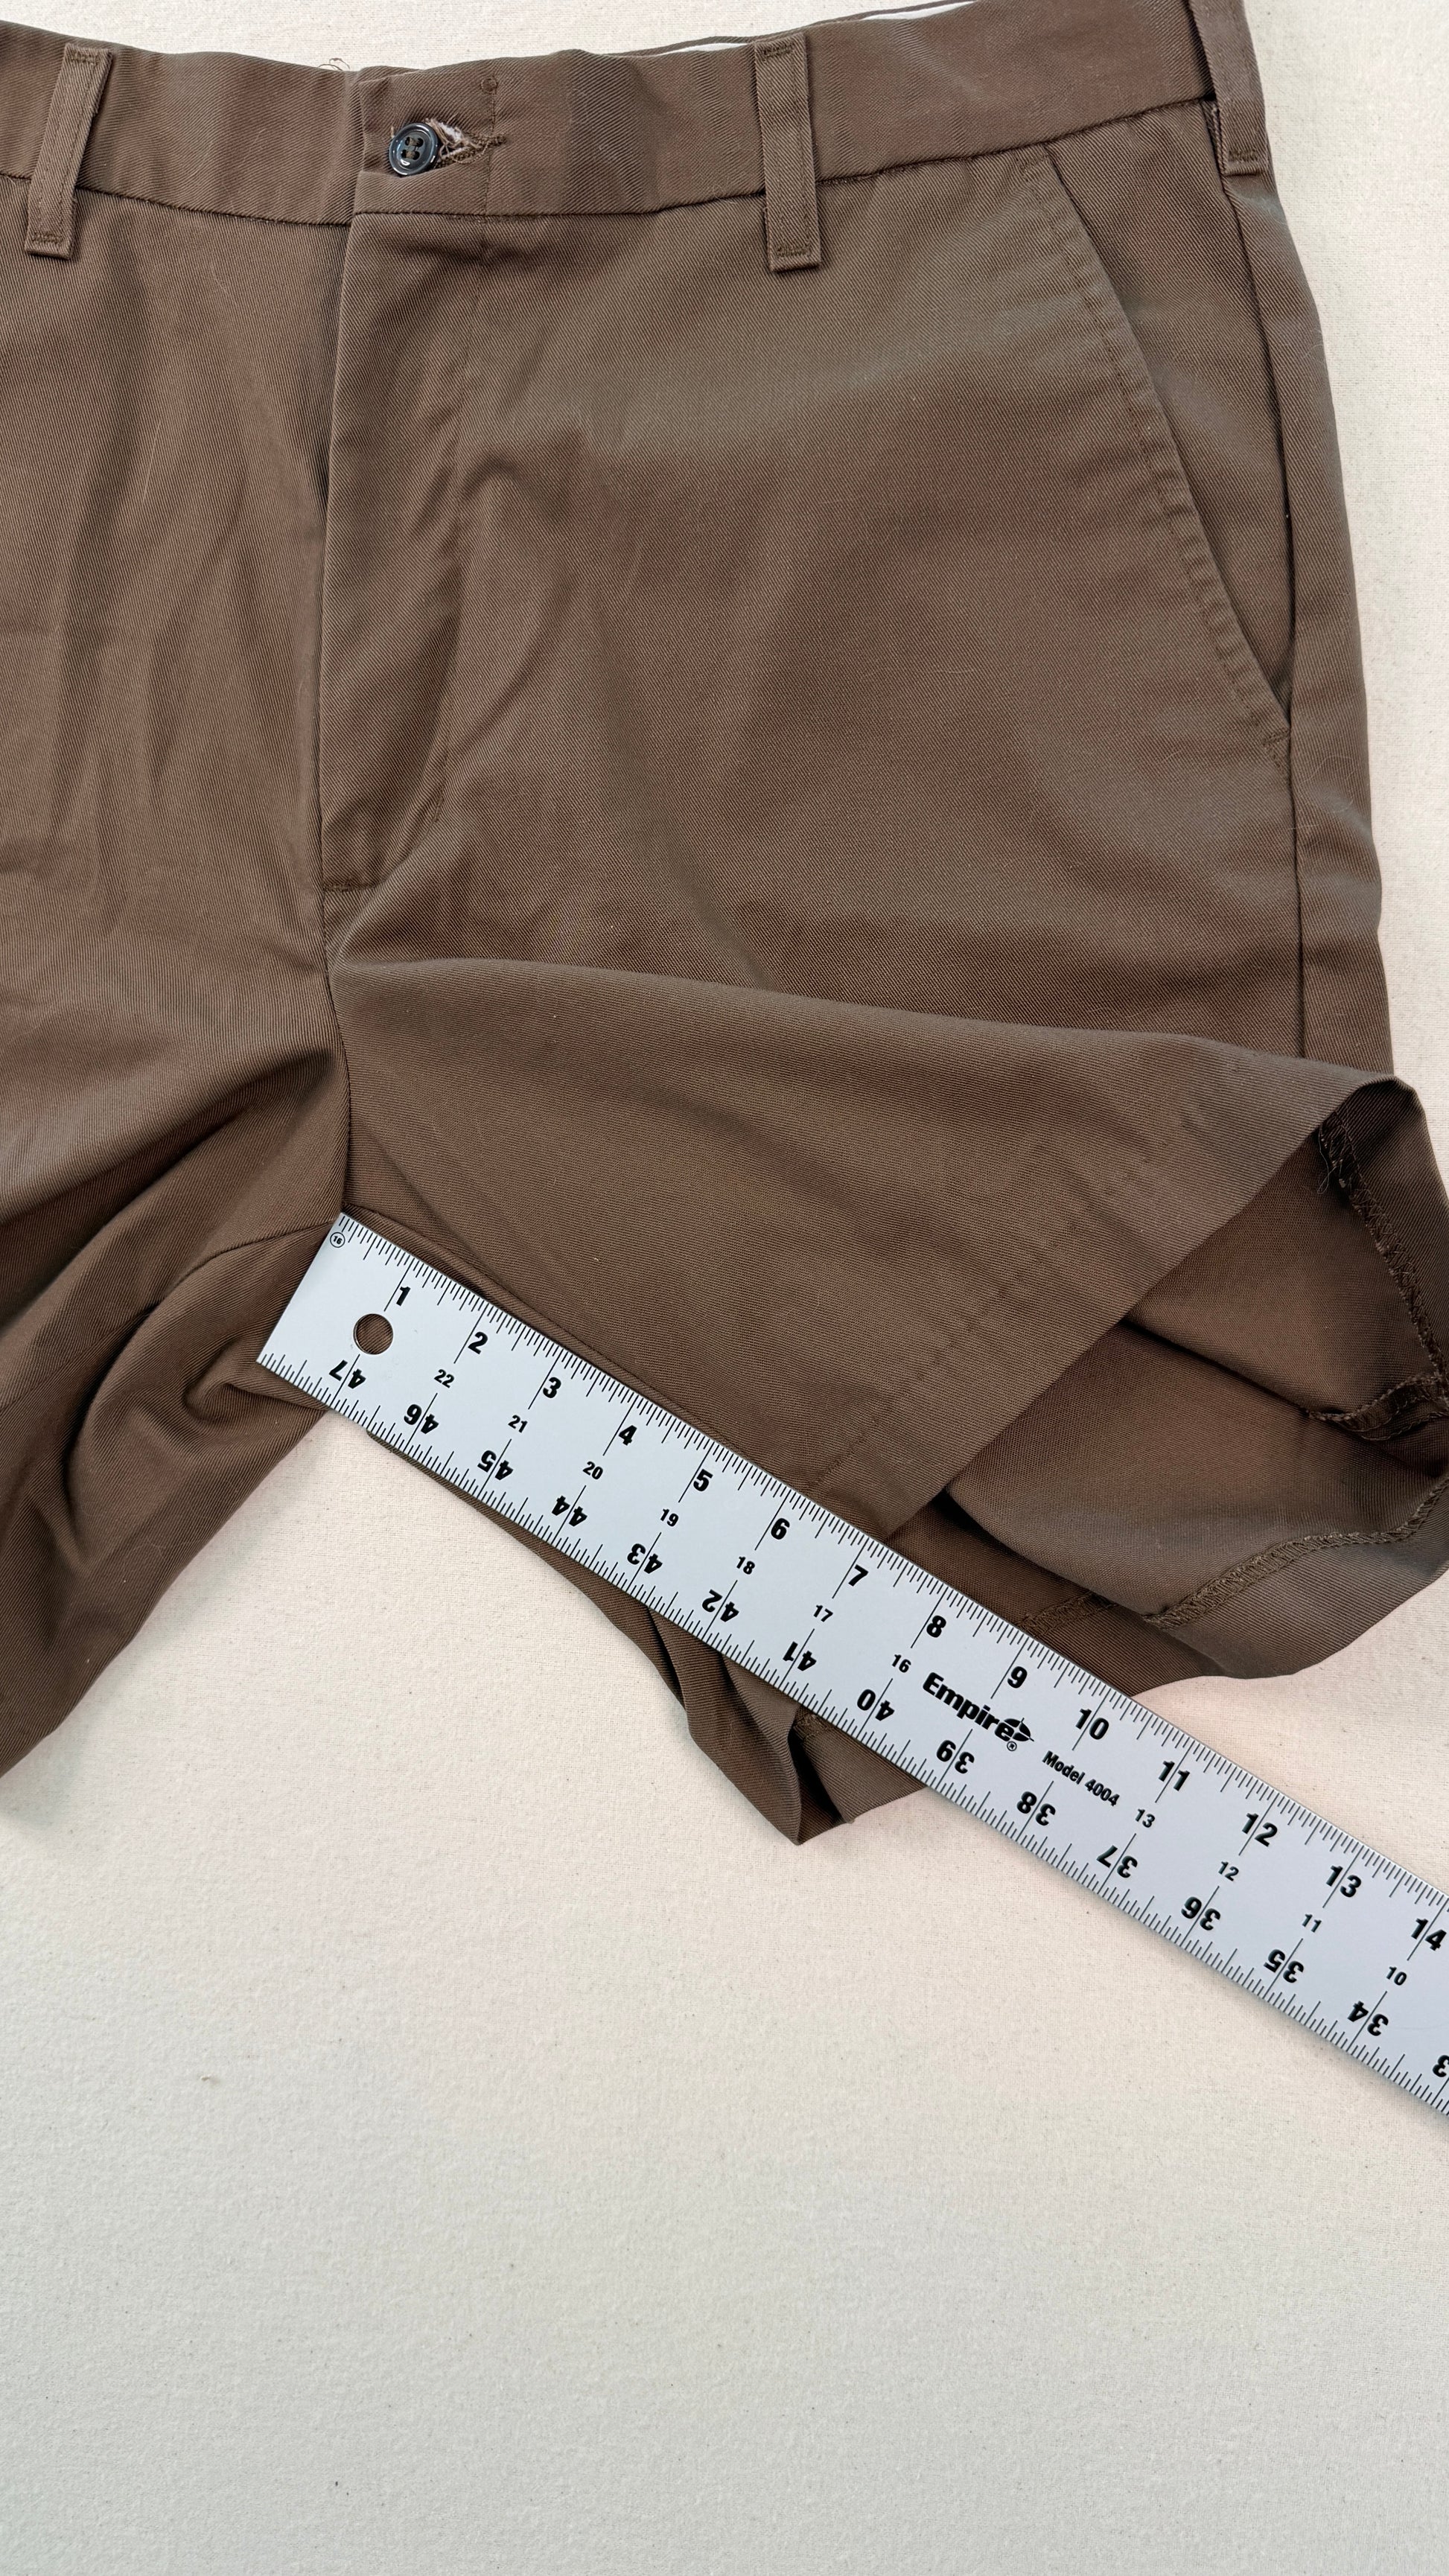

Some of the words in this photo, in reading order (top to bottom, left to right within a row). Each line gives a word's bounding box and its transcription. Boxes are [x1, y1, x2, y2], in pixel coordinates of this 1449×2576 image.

[395, 1286, 411, 1306] 1
[468, 1331, 488, 1354] 2
[329, 1359, 366, 1389] 47
[434, 1368, 455, 1388] 22
[542, 1377, 561, 1399] 3
[404, 1404, 439, 1435] 46
[508, 1415, 528, 1433] 21
[618, 1425, 637, 1445] 4
[477, 1450, 513, 1481] 45
[583, 1461, 603, 1480] 20
[693, 1469, 713, 1491] 5
[552, 1496, 587, 1527] 44
[660, 1508, 679, 1527] 19
[771, 1518, 790, 1540] 6
[627, 1543, 663, 1575] 43
[736, 1556, 755, 1575] 18
[847, 1565, 868, 1587] 7
[701, 1589, 739, 1622] 42
[813, 1604, 833, 1622] 17
[926, 1616, 946, 1638] 8
[783, 1641, 817, 1671] 41
[891, 1654, 911, 1673] 16
[1007, 1666, 1028, 1689] 9
[856, 1689, 894, 1721] 40
[922, 1671, 1015, 1743] Empire
[1072, 1708, 1109, 1740] 10
[936, 1739, 975, 1774] 39
[1042, 1750, 1084, 1785] Model
[1085, 1779, 1120, 1807] 4004
[1158, 1760, 1190, 1791] 11
[1016, 1791, 1056, 1826] 38
[1136, 1808, 1155, 1828] 13
[1241, 1812, 1278, 1846] 12
[1096, 1845, 1138, 1878] 37
[1217, 1861, 1239, 1881] 12
[1325, 1865, 1361, 1898] 13
[1181, 1896, 1221, 1931] 36
[1302, 1913, 1322, 1933] 11
[1410, 1918, 1447, 1951] 14
[1264, 1949, 1304, 1983] 35
[1386, 1966, 1407, 1986] 10
[1347, 2000, 1389, 2036] 34
